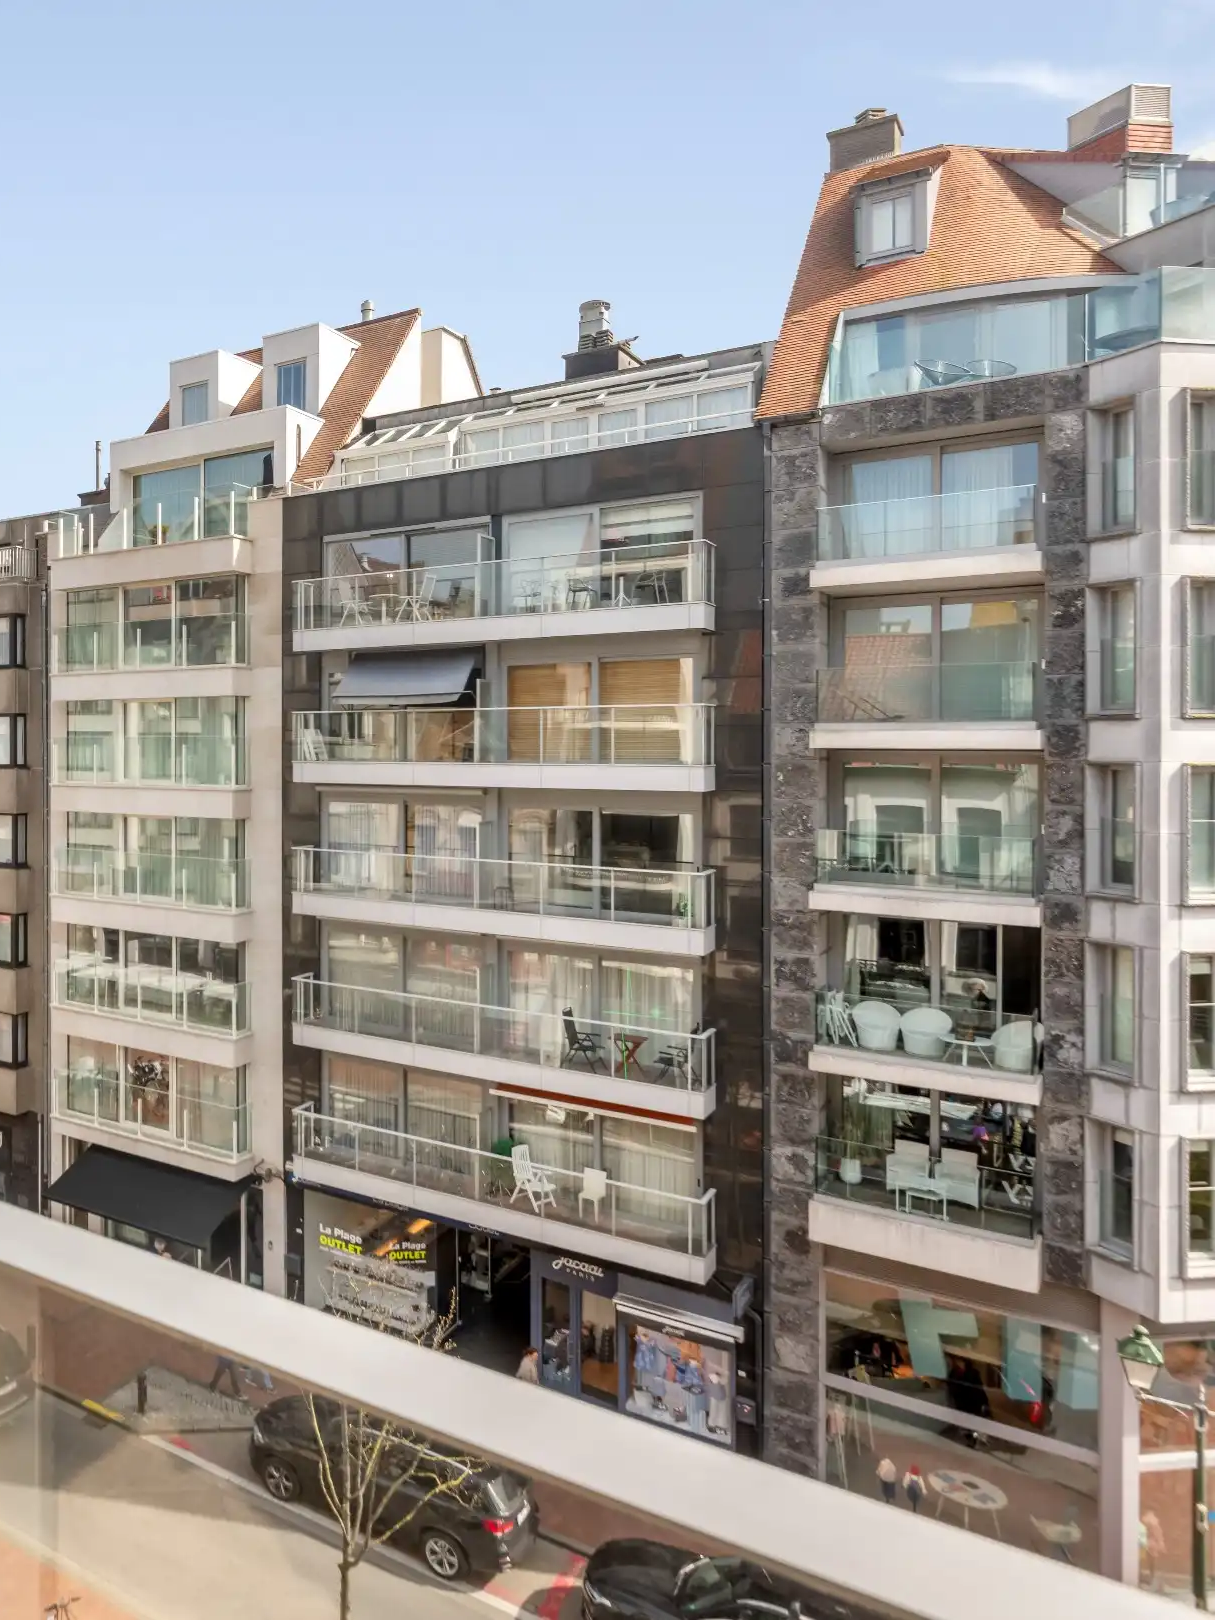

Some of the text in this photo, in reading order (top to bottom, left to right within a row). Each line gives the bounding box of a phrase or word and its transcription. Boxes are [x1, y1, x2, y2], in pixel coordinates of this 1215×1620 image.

[319, 1222, 363, 1245] La Plage
[319, 1234, 363, 1257] OUTLET
[402, 1241, 427, 1251] Plage
[389, 1250, 427, 1260] OUTLET
